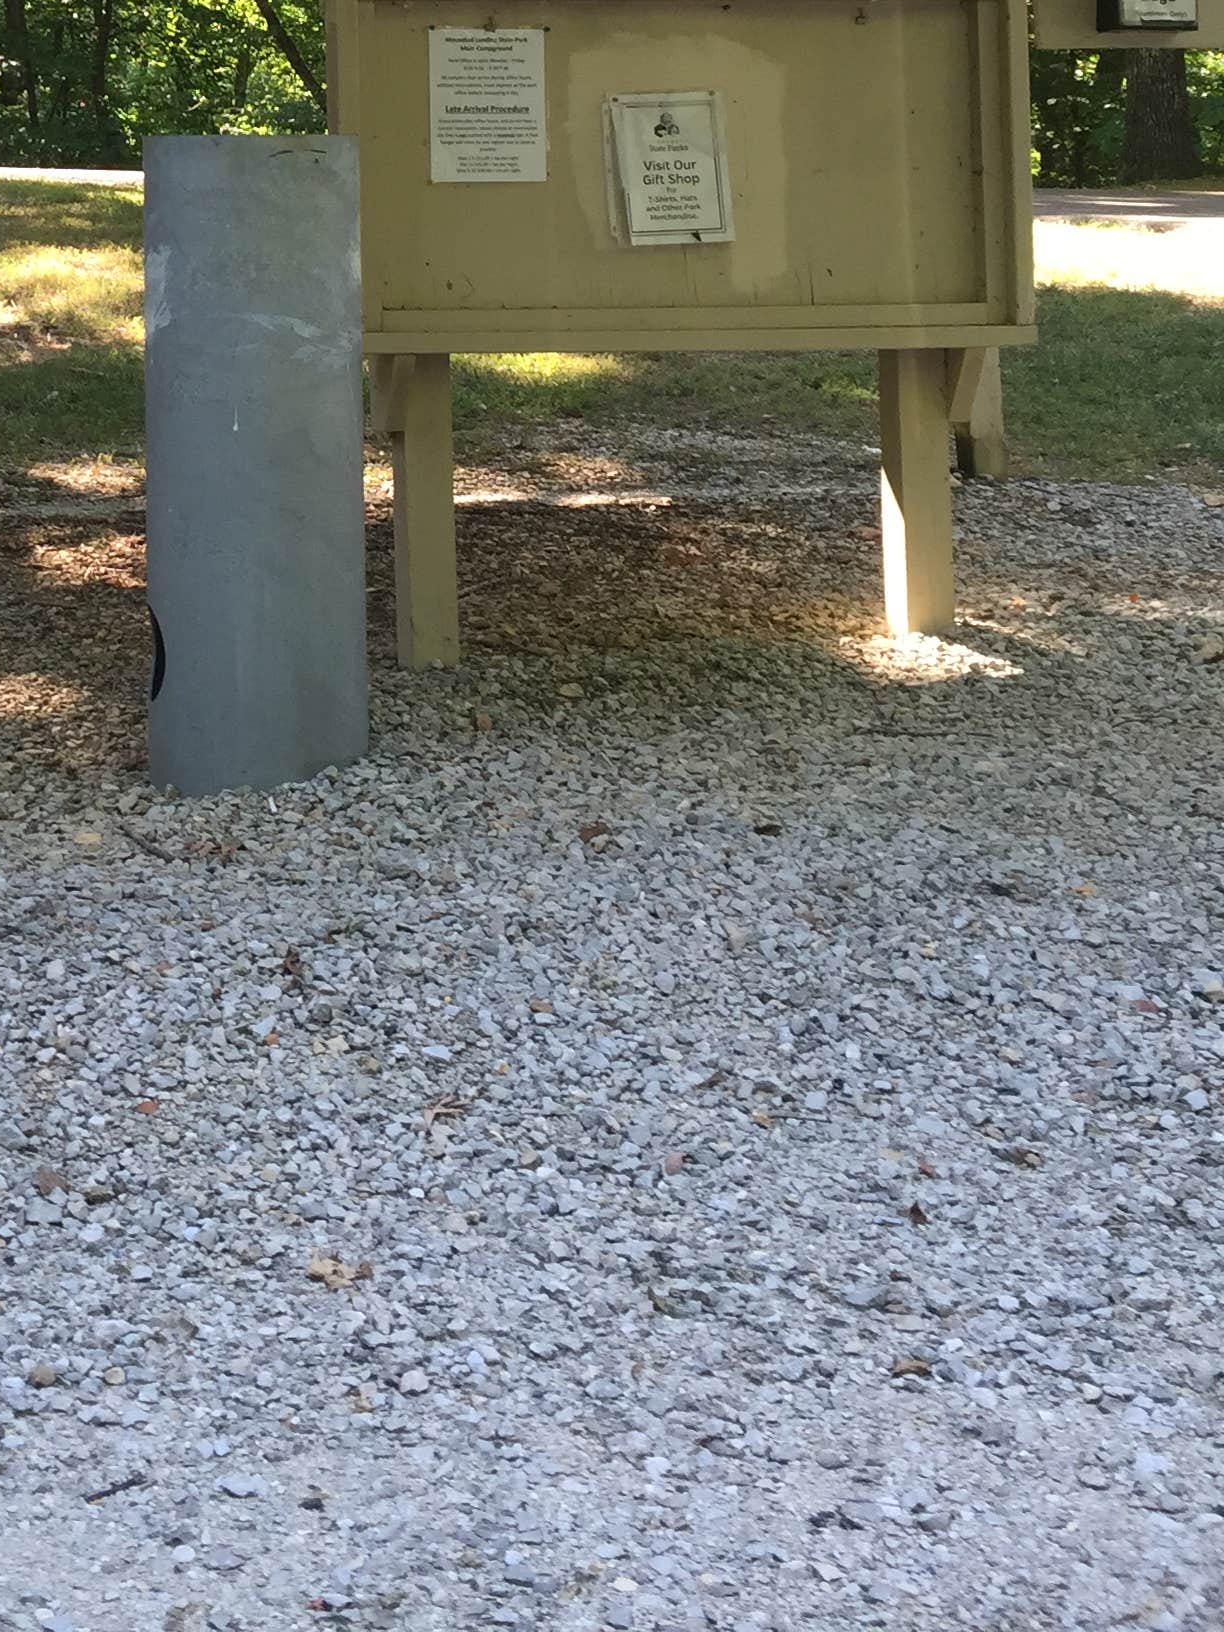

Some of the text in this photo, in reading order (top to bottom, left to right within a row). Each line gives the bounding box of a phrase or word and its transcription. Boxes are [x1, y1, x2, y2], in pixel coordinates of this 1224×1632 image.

[643, 159, 697, 172] Visit Our
[642, 173, 700, 186] Gift Shop
